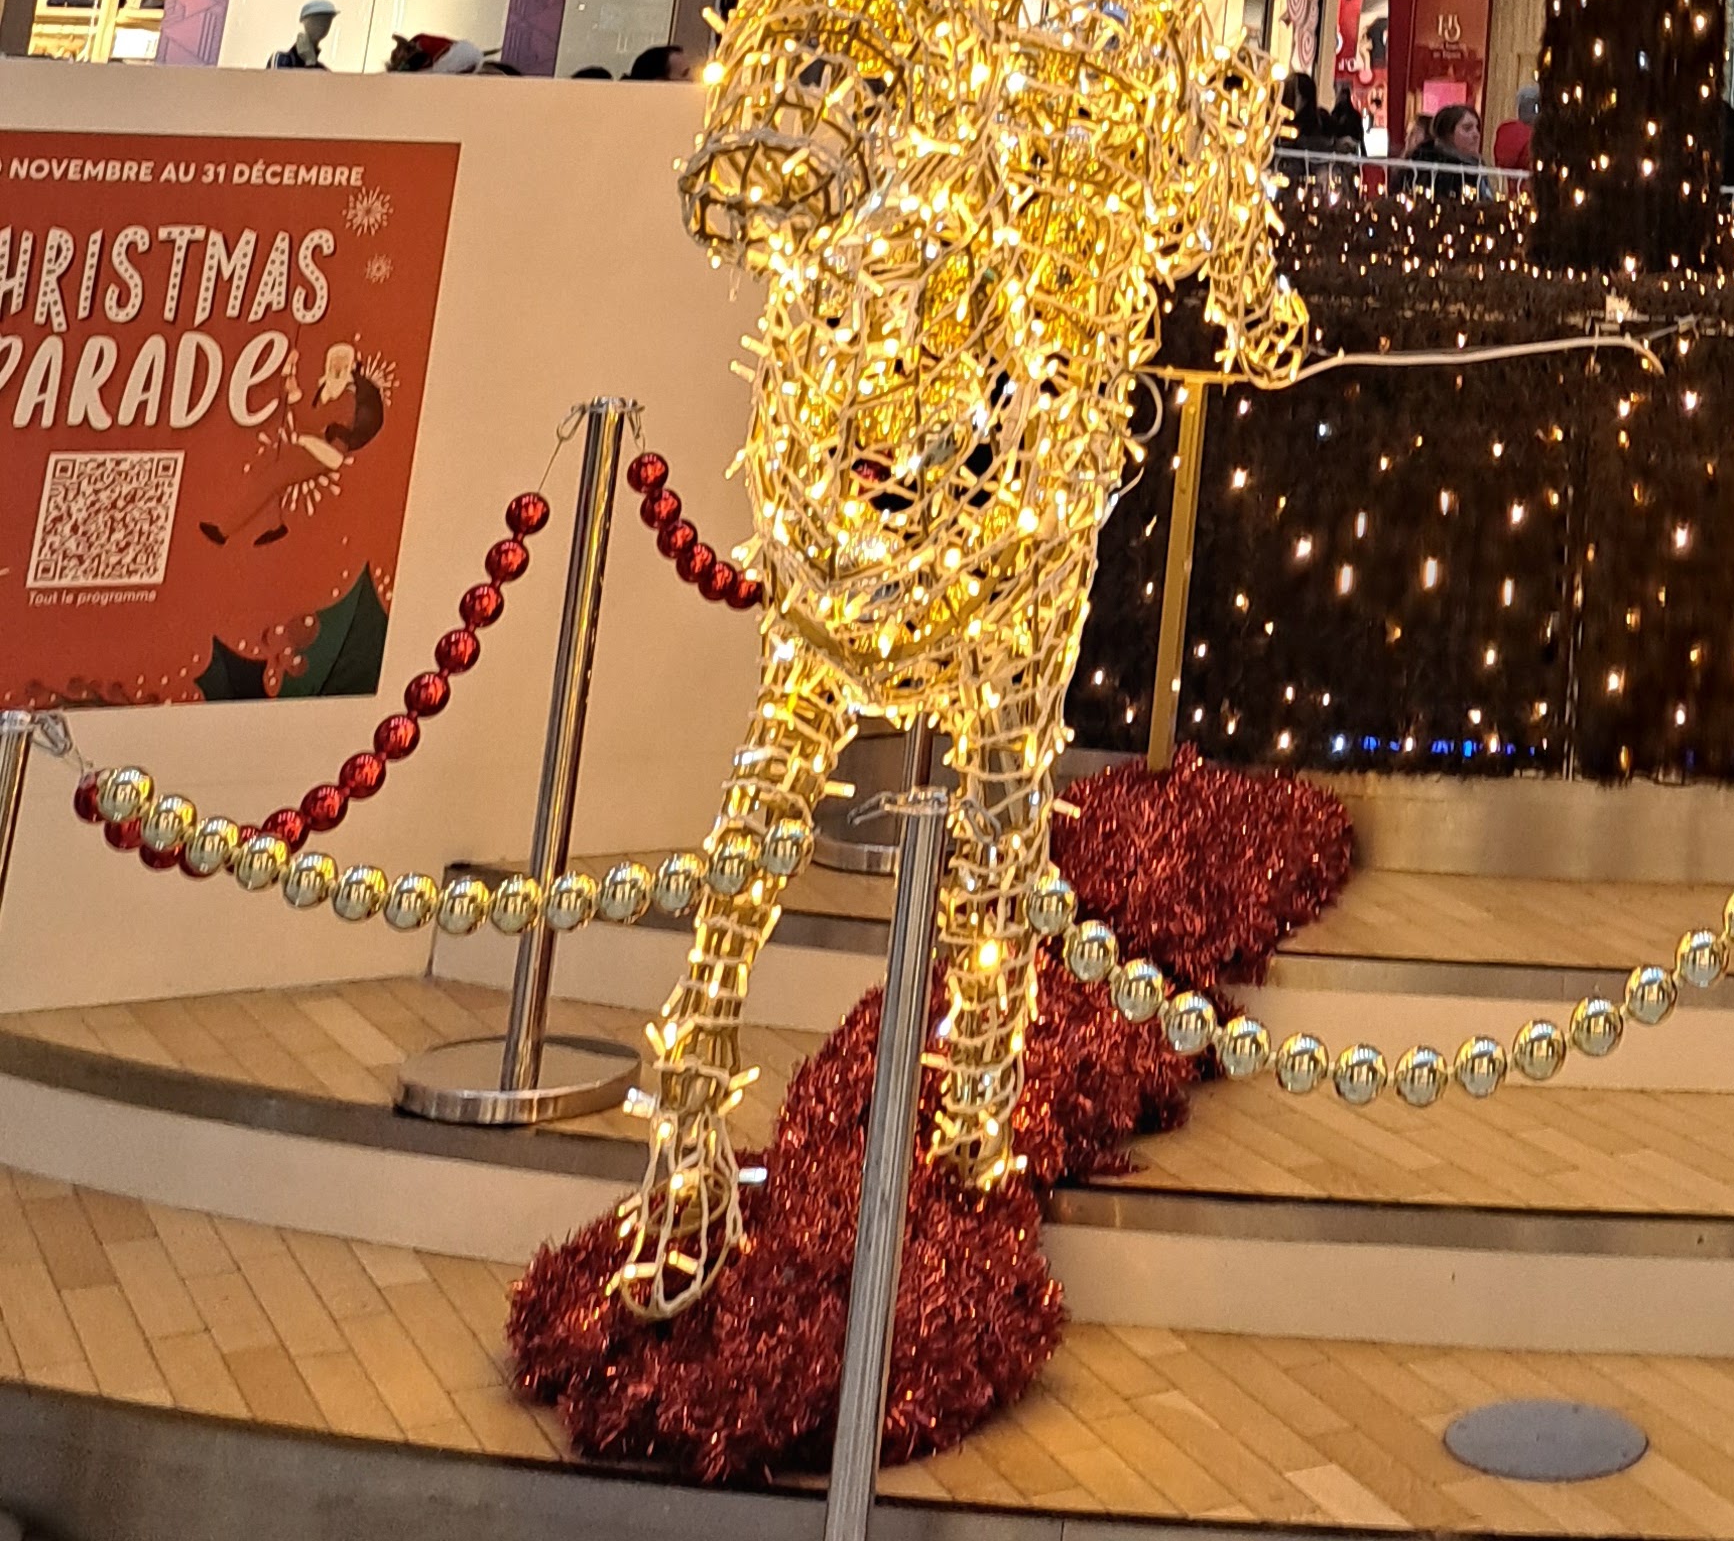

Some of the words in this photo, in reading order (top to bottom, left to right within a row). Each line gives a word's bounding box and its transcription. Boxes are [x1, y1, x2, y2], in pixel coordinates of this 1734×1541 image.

[9, 157, 155, 182] NOVEMBRE
[159, 161, 196, 184] AU
[201, 162, 227, 185] 31
[232, 158, 365, 187] DÉCEMBRE
[0, 224, 335, 332] HRISTMAS
[28, 590, 57, 607] Tout
[61, 590, 74, 605] le
[76, 589, 157, 608] programme
